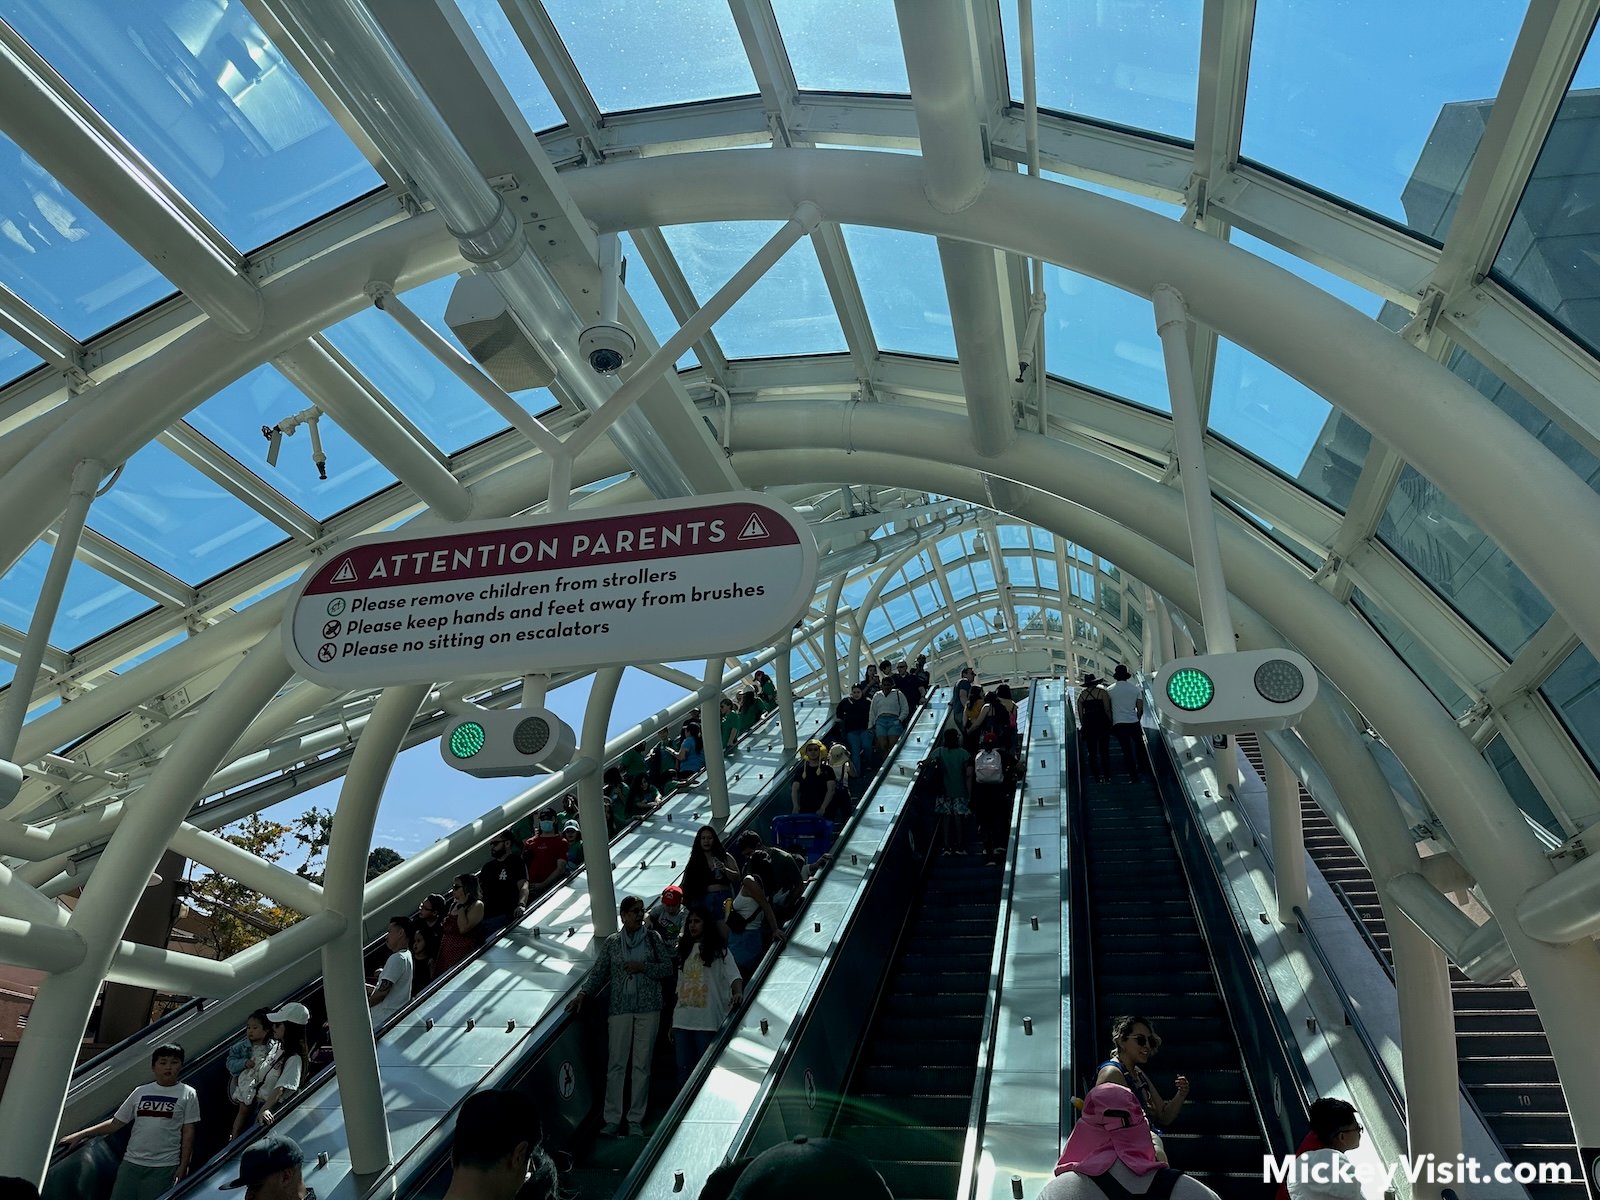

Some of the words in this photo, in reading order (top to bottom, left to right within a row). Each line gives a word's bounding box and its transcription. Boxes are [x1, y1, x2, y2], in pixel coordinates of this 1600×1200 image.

[368, 537, 559, 580] ATTENTION
[571, 519, 727, 558] PARENTS
[346, 618, 402, 635] Please
[407, 613, 448, 631] keep
[453, 606, 505, 625] hands
[509, 601, 543, 620] and
[548, 598, 585, 616] feet
[590, 596, 637, 613] away
[641, 590, 686, 607] from
[691, 582, 765, 602] brushes
[351, 596, 406, 613] Please
[410, 591, 475, 607] remove
[479, 581, 550, 600] children
[555, 577, 597, 593] from
[603, 568, 677, 588] strollers
[342, 641, 398, 658] Please
[402, 638, 424, 652] no
[428, 631, 485, 649] sitting
[489, 630, 511, 644] on
[516, 621, 610, 641] escalators
[1518, 1095, 1531, 1106] 10
